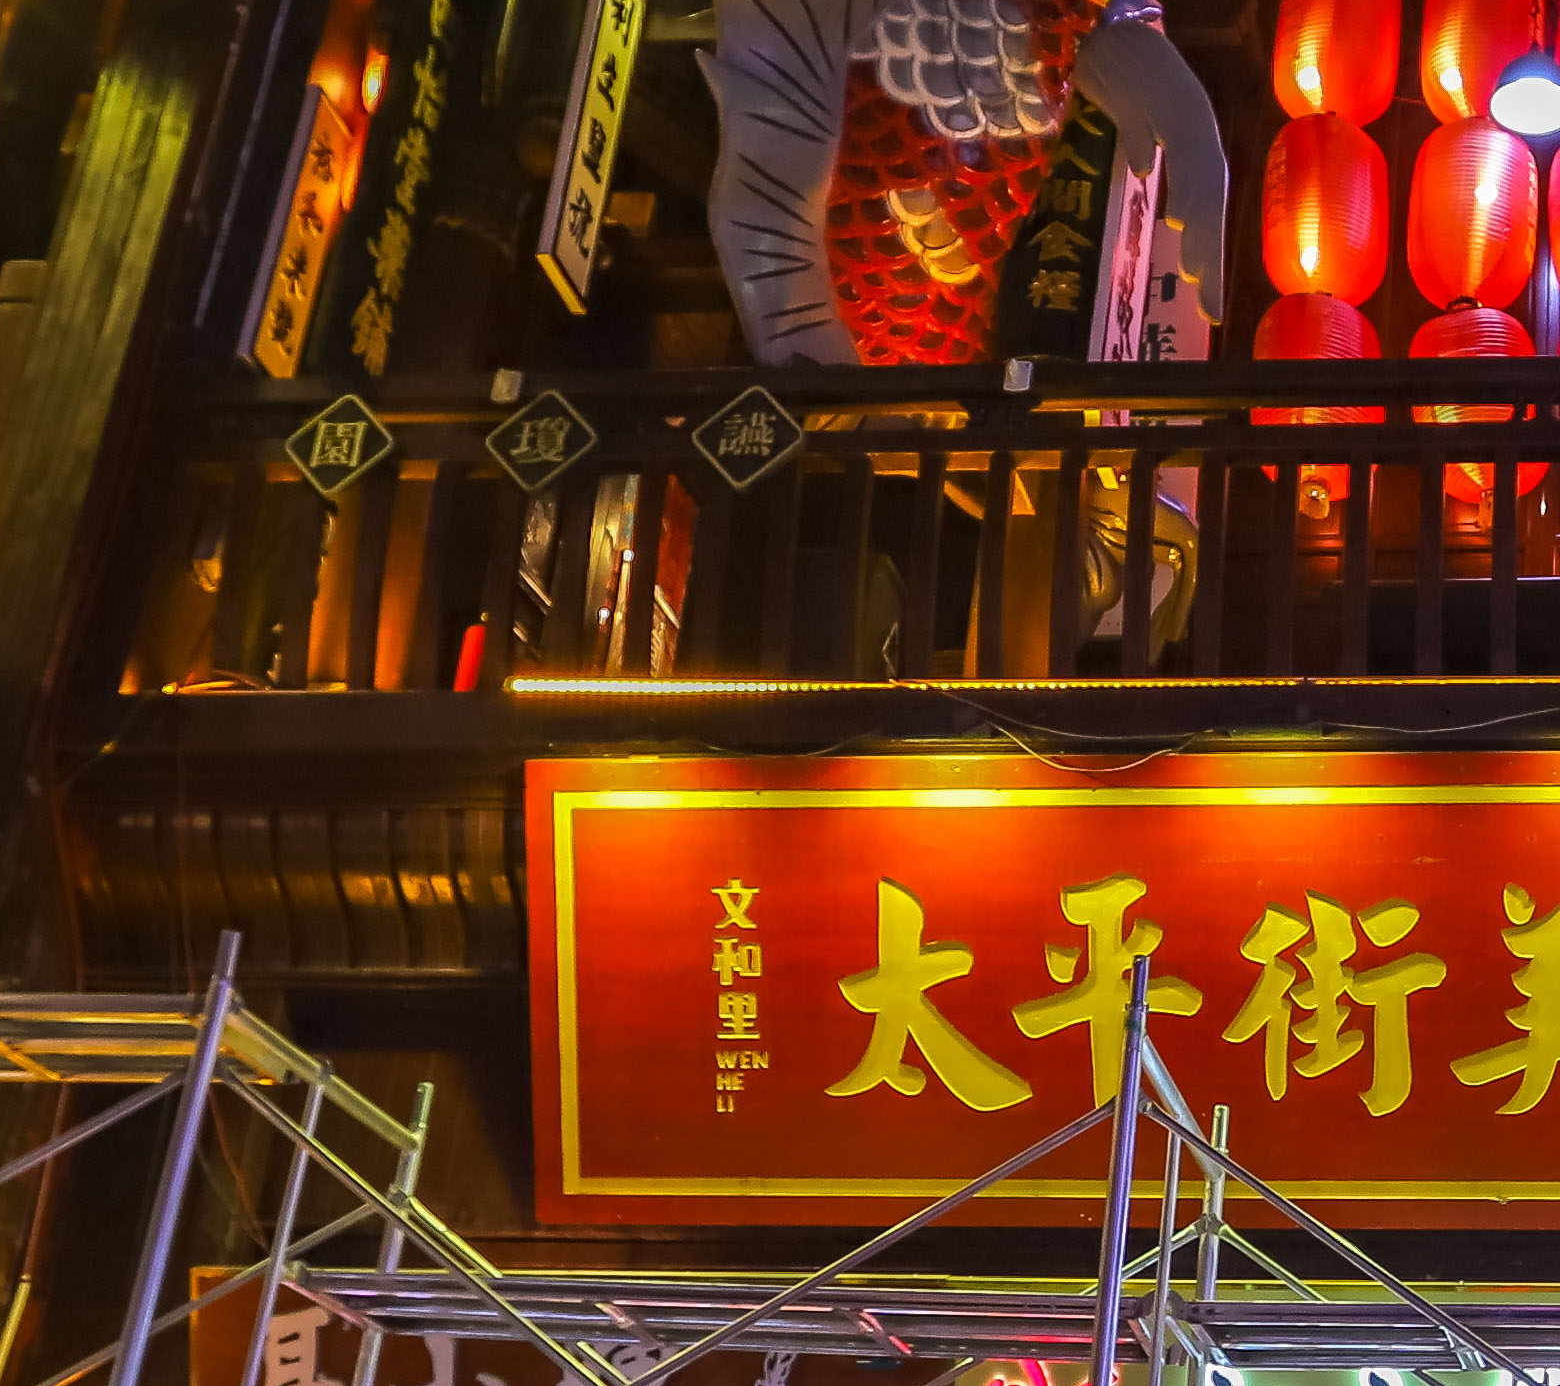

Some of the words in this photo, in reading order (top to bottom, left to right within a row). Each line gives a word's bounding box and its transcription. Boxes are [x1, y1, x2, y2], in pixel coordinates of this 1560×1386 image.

[711, 877, 763, 1042] 文和里
[715, 1049, 770, 1072] WEN
[716, 1072, 745, 1093] HE
